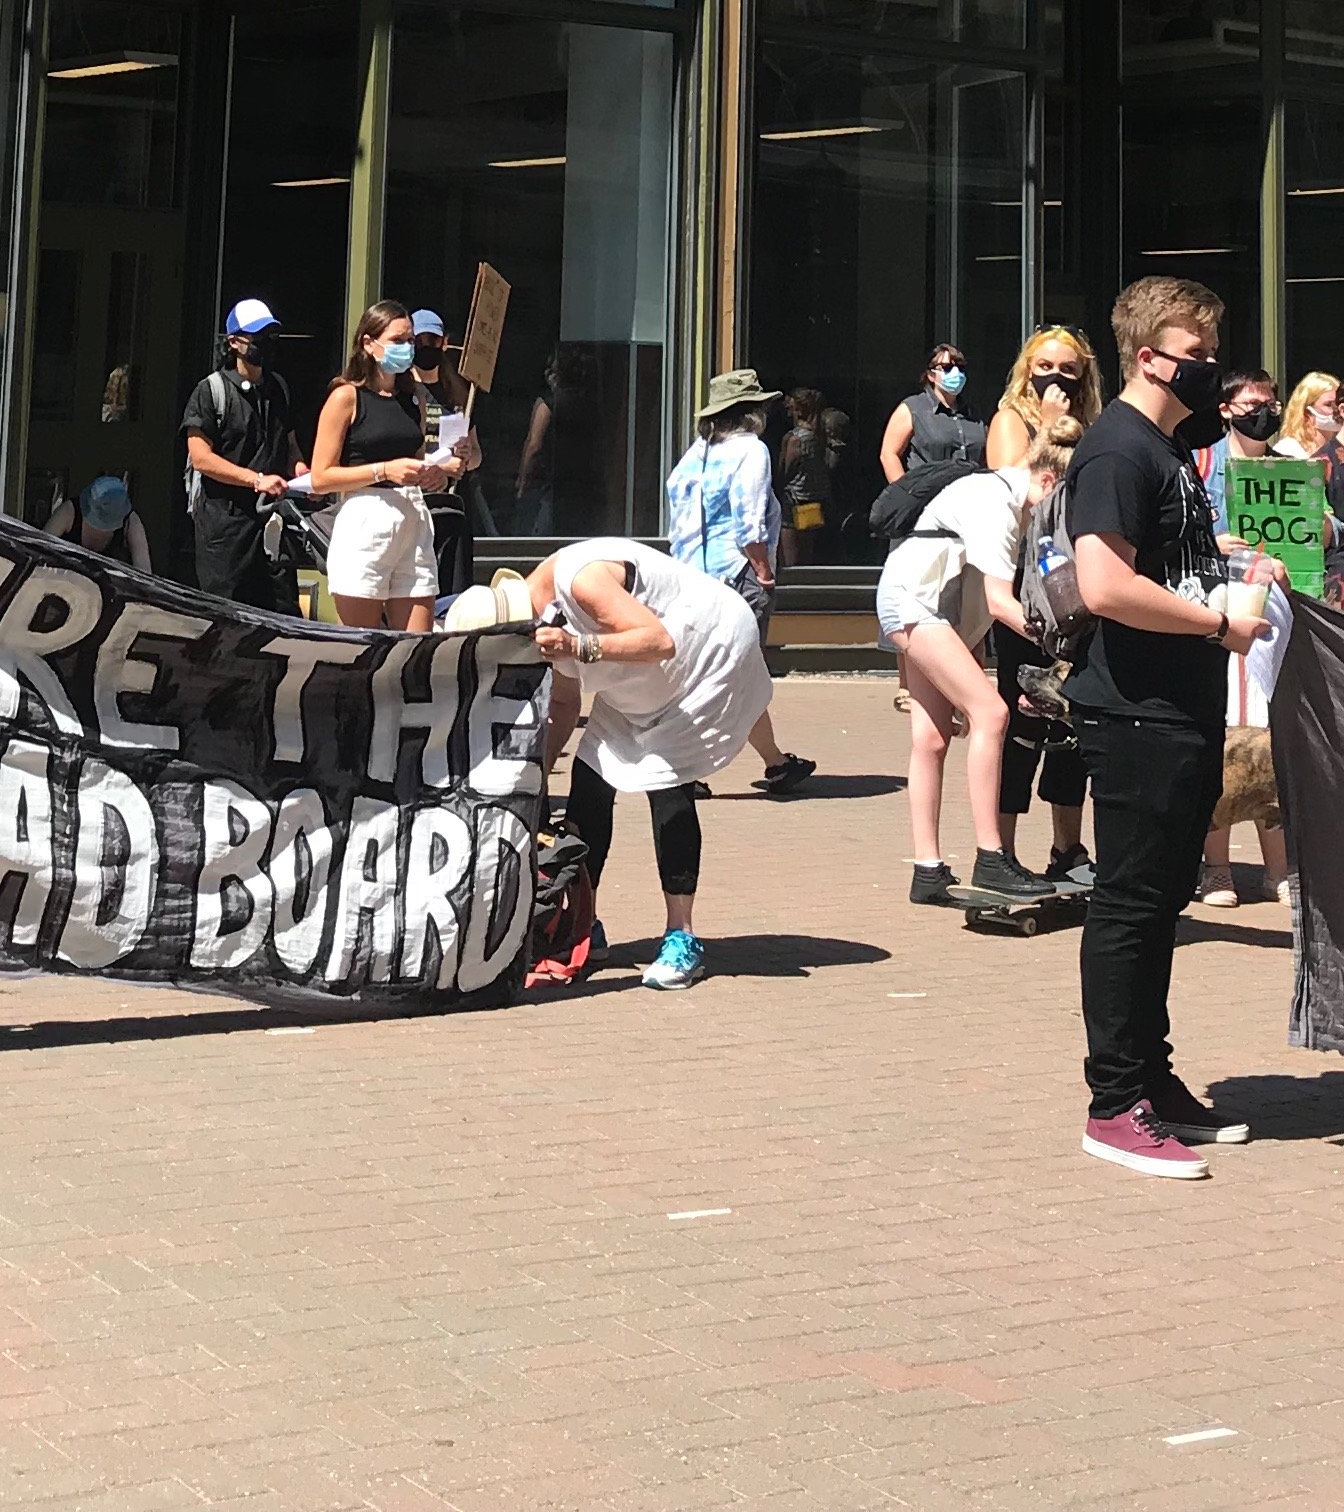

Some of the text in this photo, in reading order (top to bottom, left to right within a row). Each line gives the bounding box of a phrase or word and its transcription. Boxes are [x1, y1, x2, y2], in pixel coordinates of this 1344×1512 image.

[1237, 477, 1305, 506] THE
[1238, 515, 1318, 547] BOG
[261, 633, 552, 798] THE
[191, 778, 536, 993] BOARD
